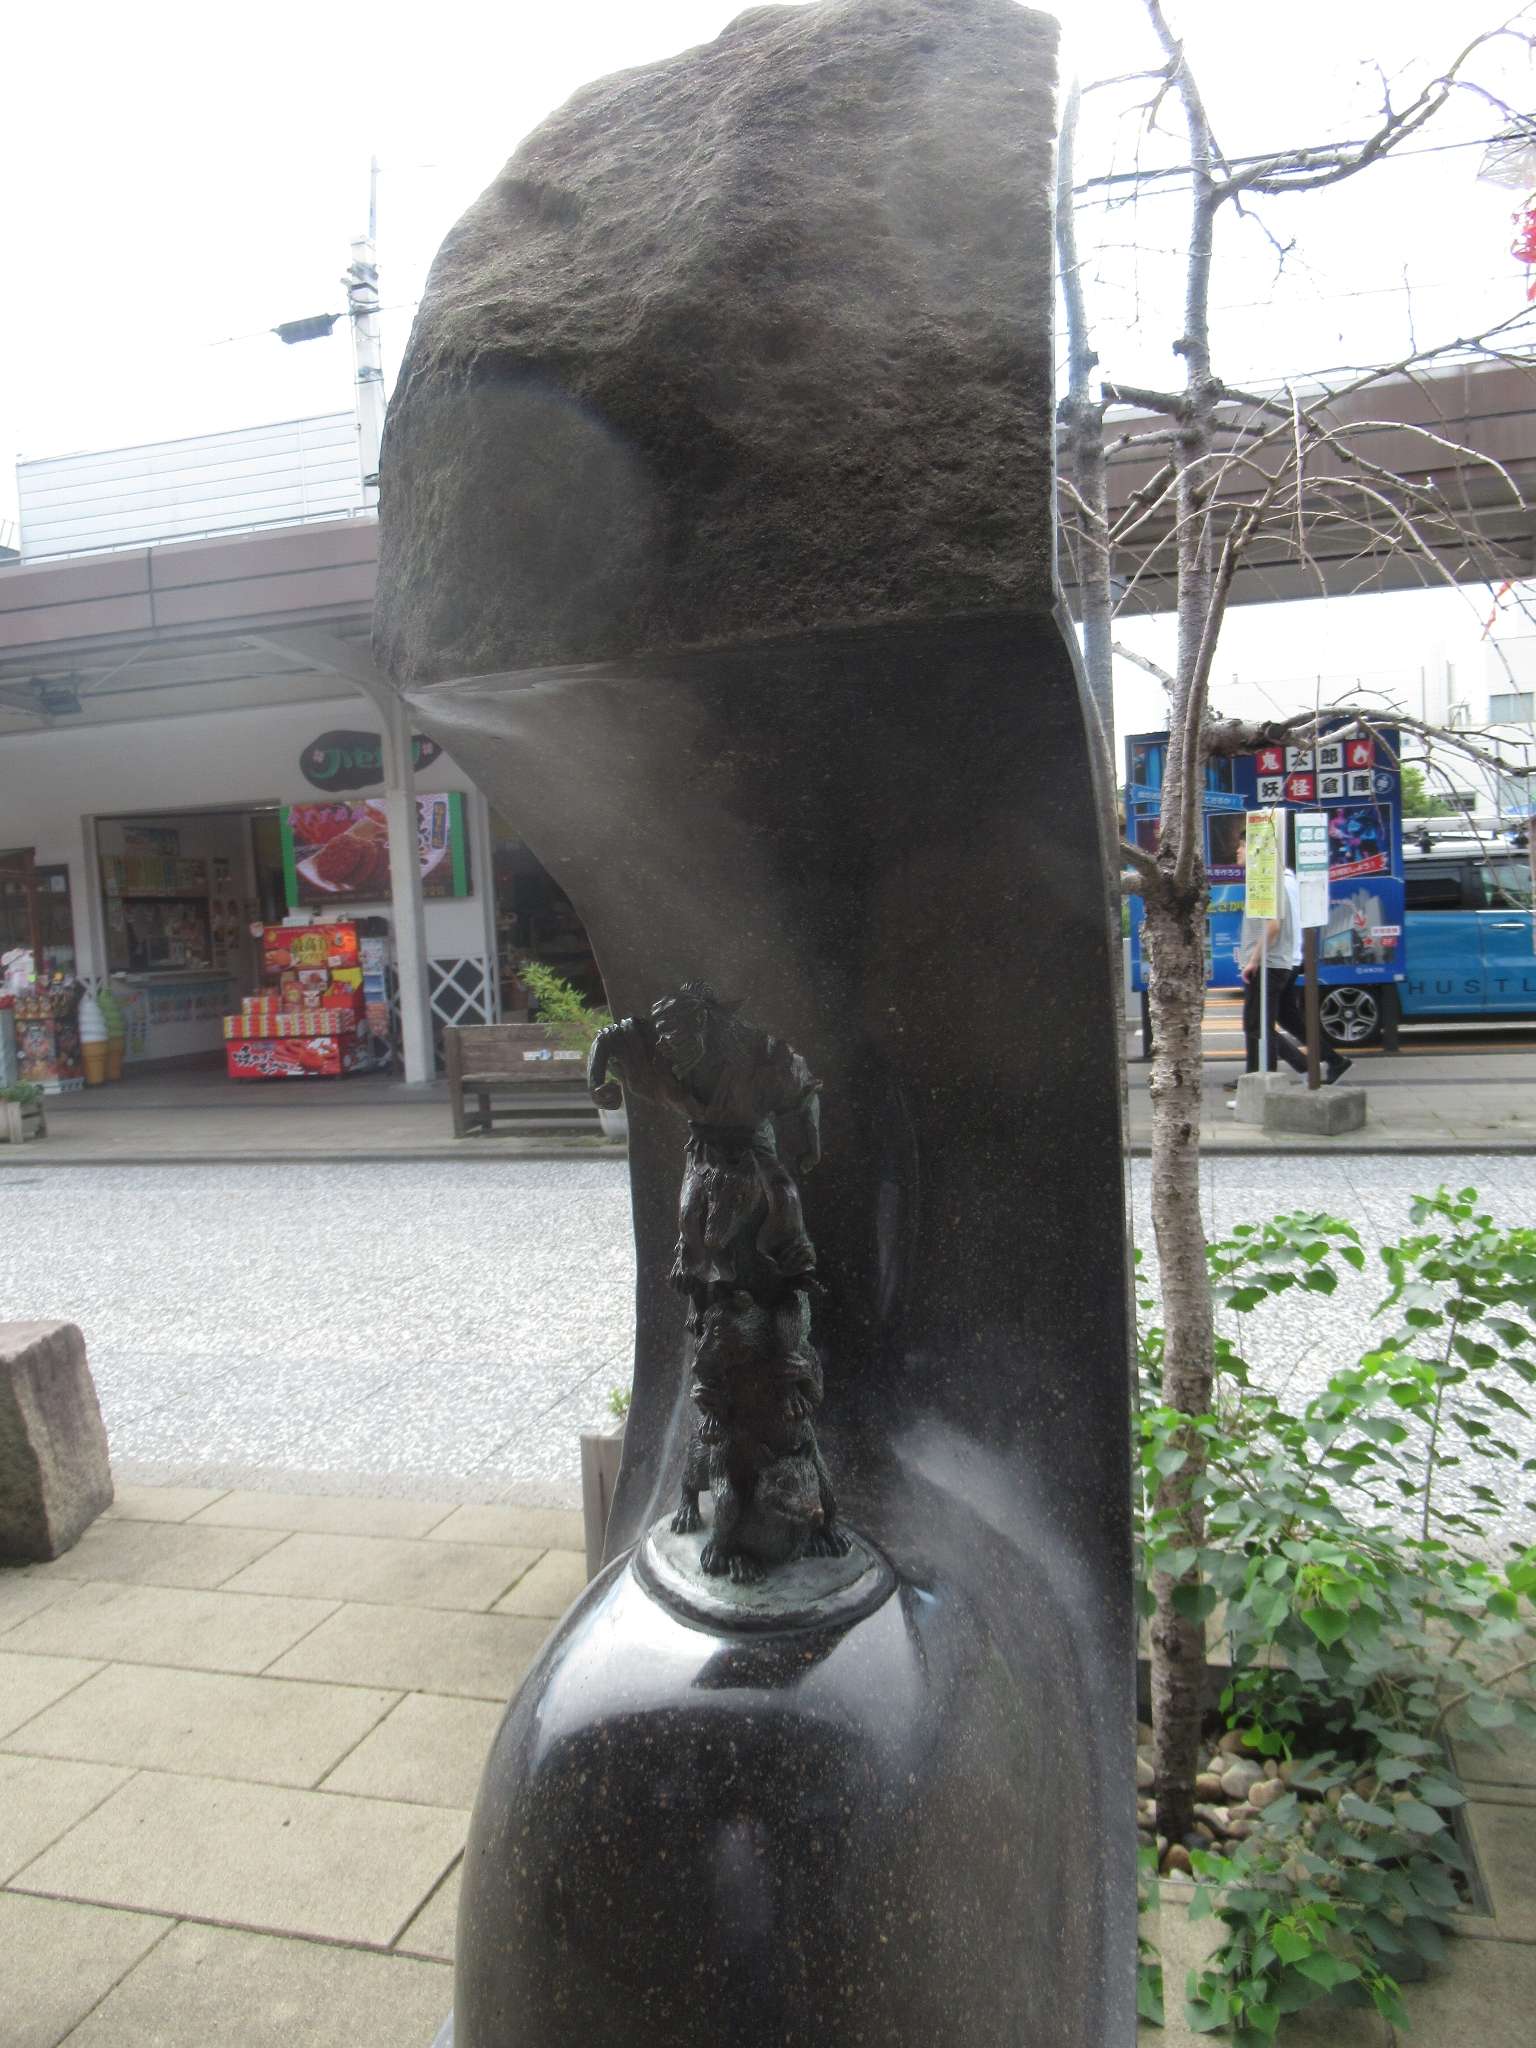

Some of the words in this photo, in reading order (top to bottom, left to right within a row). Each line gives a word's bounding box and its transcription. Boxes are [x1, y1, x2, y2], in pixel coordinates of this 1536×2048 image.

[1261, 747, 1339, 771] 鬼太郎
[1261, 775, 1370, 798] 妖怪倉庫
